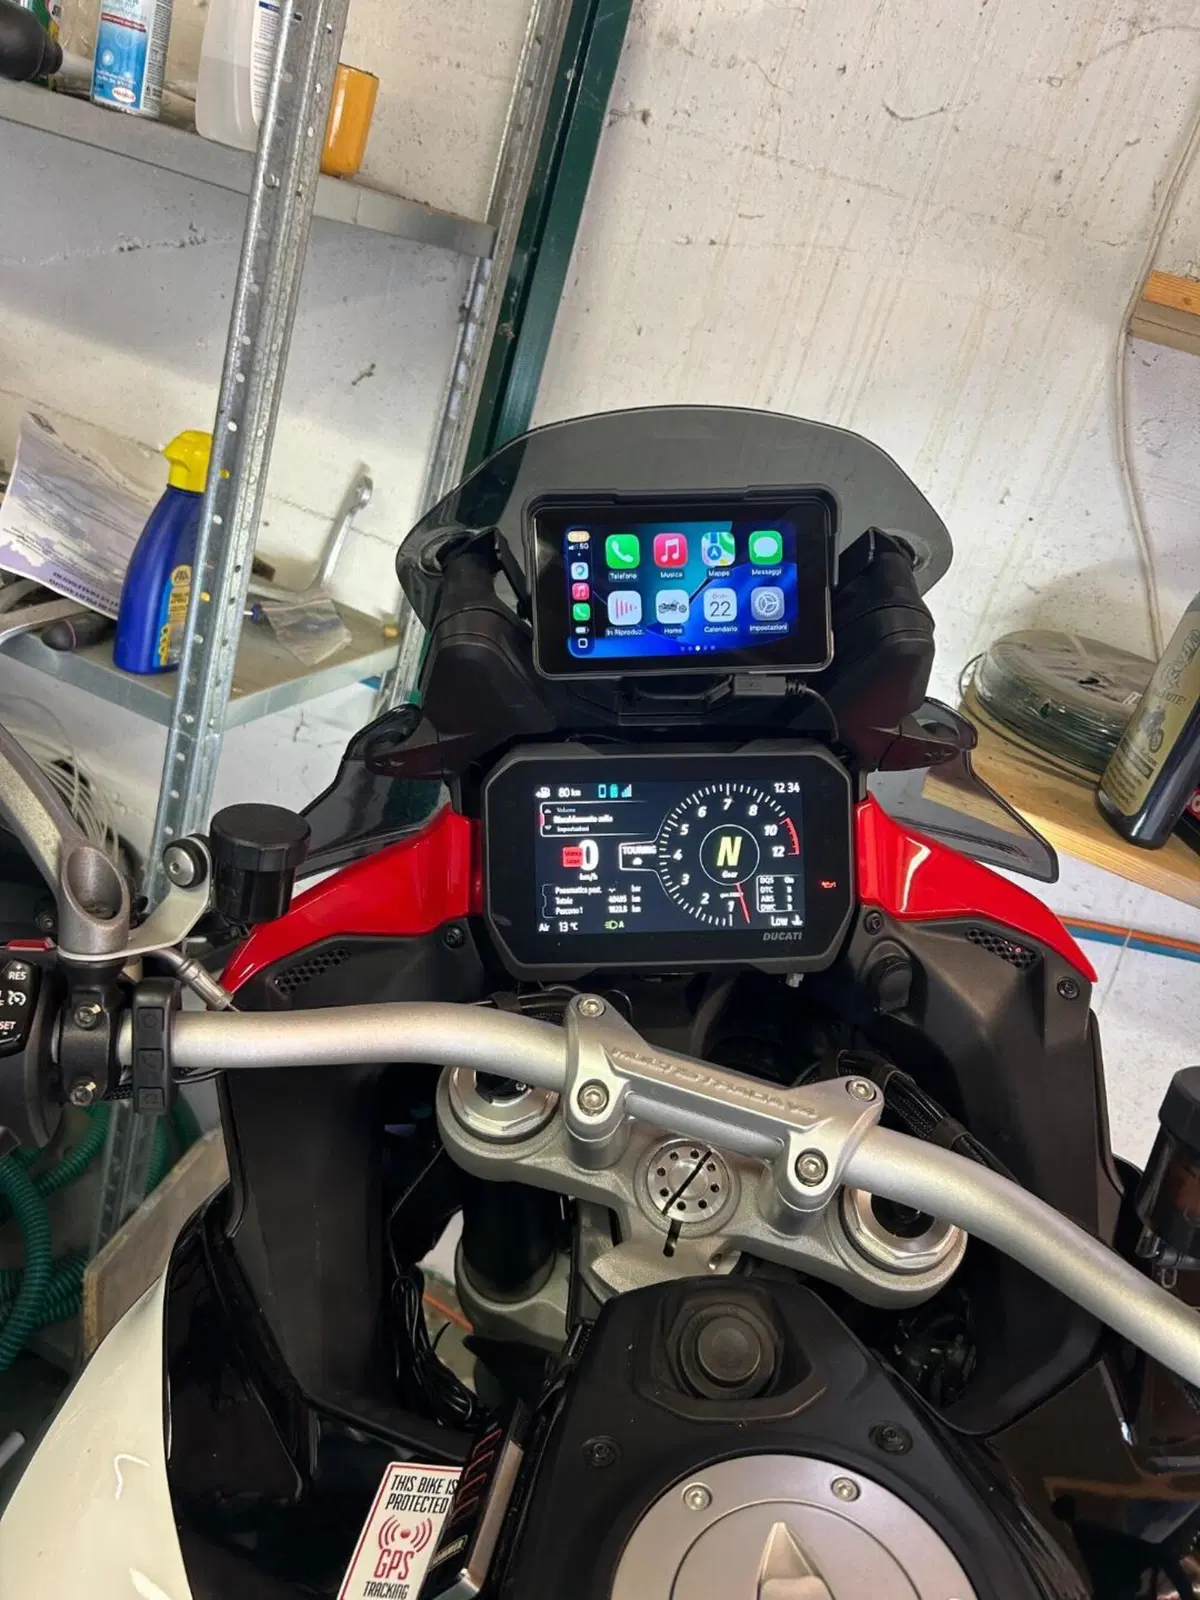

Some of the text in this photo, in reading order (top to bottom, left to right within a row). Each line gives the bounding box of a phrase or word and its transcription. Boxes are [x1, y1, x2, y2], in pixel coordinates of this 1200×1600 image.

[610, 572, 637, 580] Telefono
[660, 571, 683, 579] Musica
[751, 568, 782, 576] Messaggi
[710, 601, 731, 617] 22
[704, 625, 738, 633] Calendario
[749, 623, 788, 632] Impostazioni
[558, 787, 582, 798] 80 km
[723, 798, 733, 811] 7
[749, 805, 758, 816] 8
[697, 806, 707, 818] 6
[680, 823, 689, 836] 5
[764, 824, 778, 836] 10
[579, 839, 599, 871] 0
[622, 845, 657, 855] TOURING
[673, 849, 683, 861] 4
[716, 836, 743, 867] N
[772, 846, 785, 858] 12
[681, 873, 690, 886] 3
[700, 893, 710, 905] 2
[538, 922, 551, 932] Air
[558, 921, 569, 933] 13
[770, 916, 788, 926] Low
[762, 932, 803, 941] DUCATI
[8, 971, 27, 981] RES
[0, 1021, 17, 1030] SET
[390, 1474, 459, 1495] THIS BIKE IS
[385, 1493, 450, 1514] PROTECTED
[373, 1548, 415, 1581] GPS
[362, 1580, 410, 1600] TRACKING
